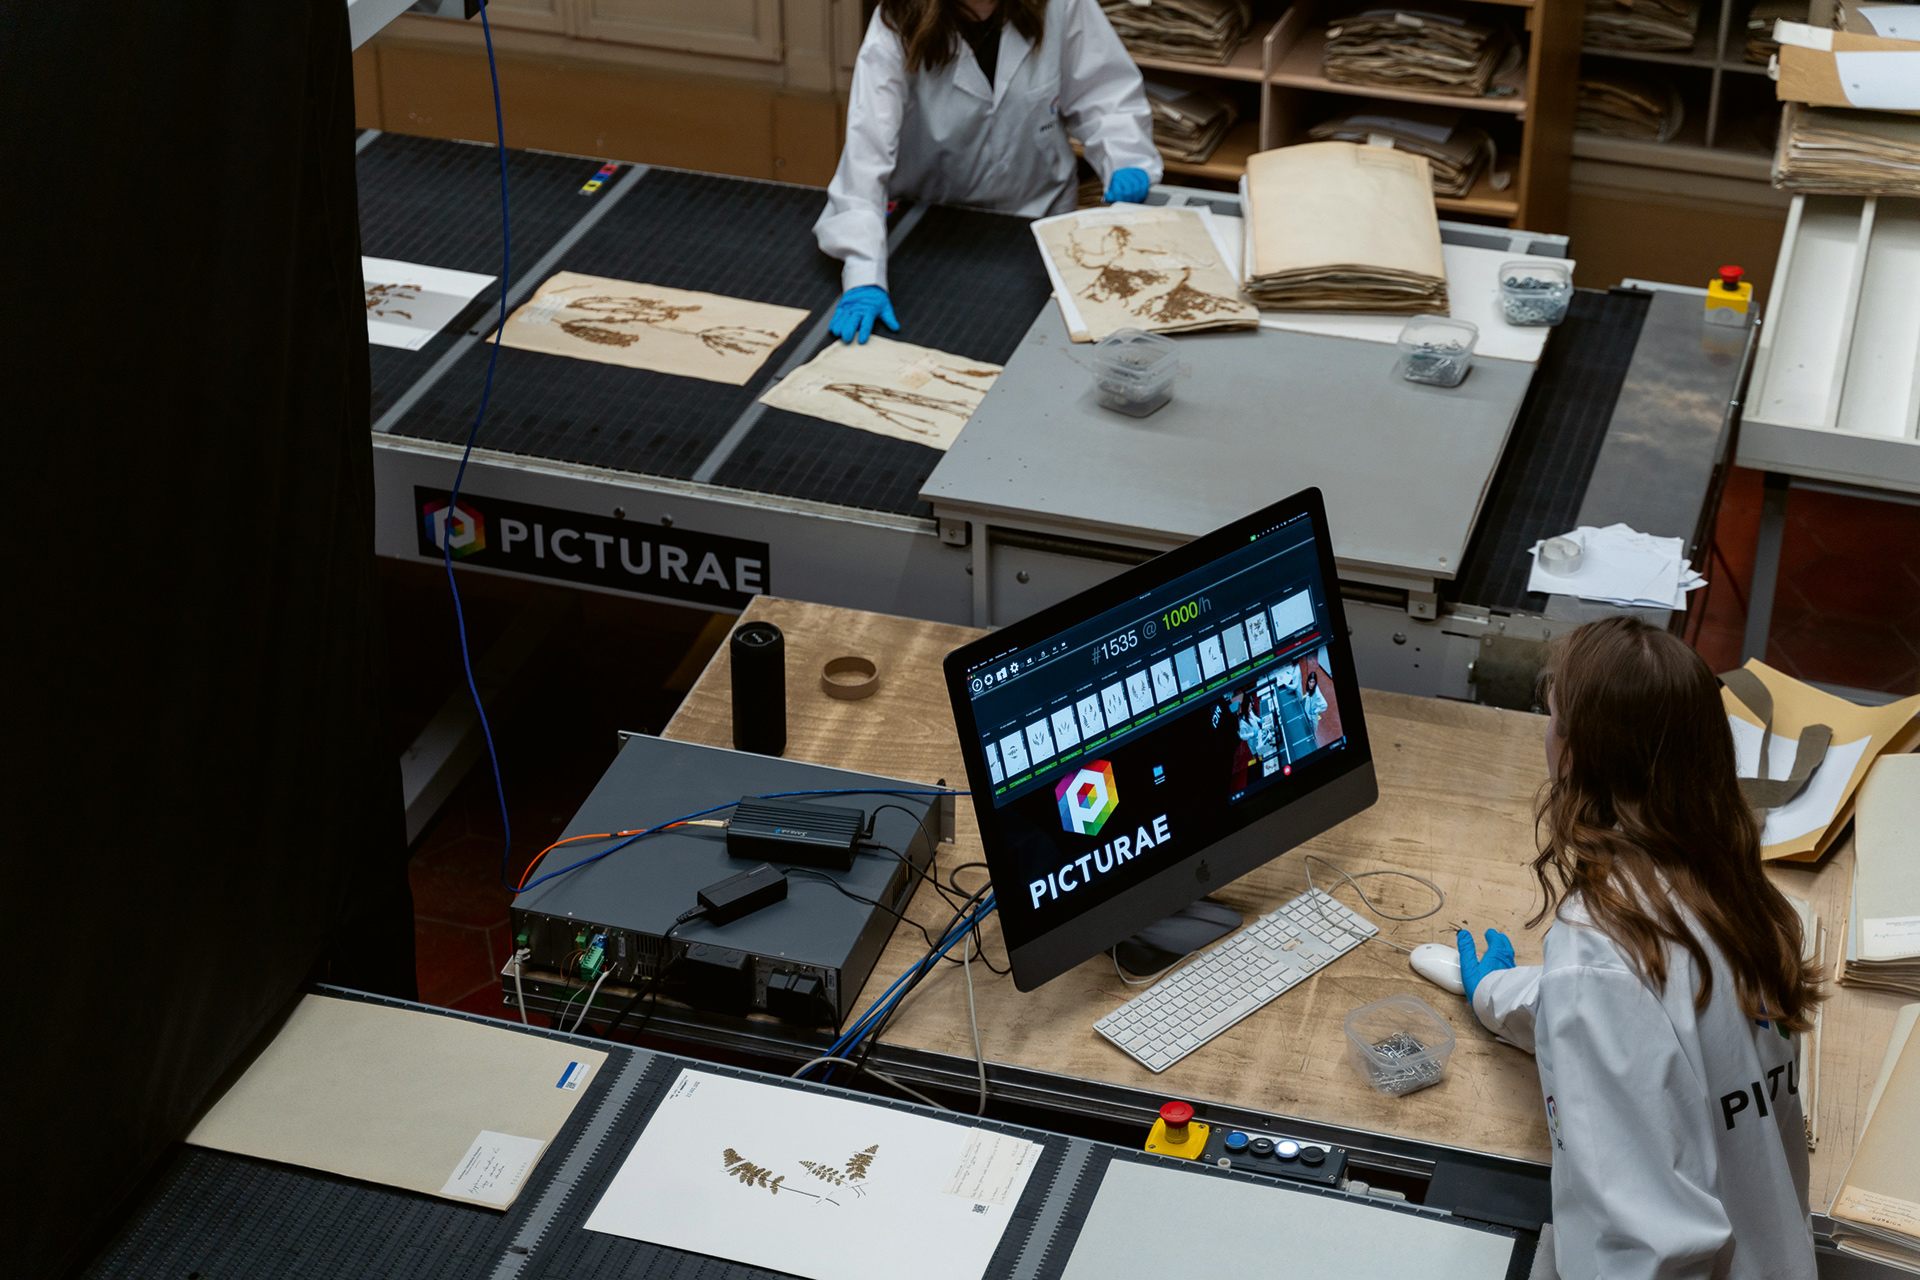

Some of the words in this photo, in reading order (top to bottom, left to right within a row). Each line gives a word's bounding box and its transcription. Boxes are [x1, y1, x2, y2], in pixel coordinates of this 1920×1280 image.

[500, 517, 763, 595] PICTURAE
[1092, 629, 1138, 666] #1535
[1162, 596, 1212, 631] 1000/h
[1029, 813, 1172, 910] PICTURAE
